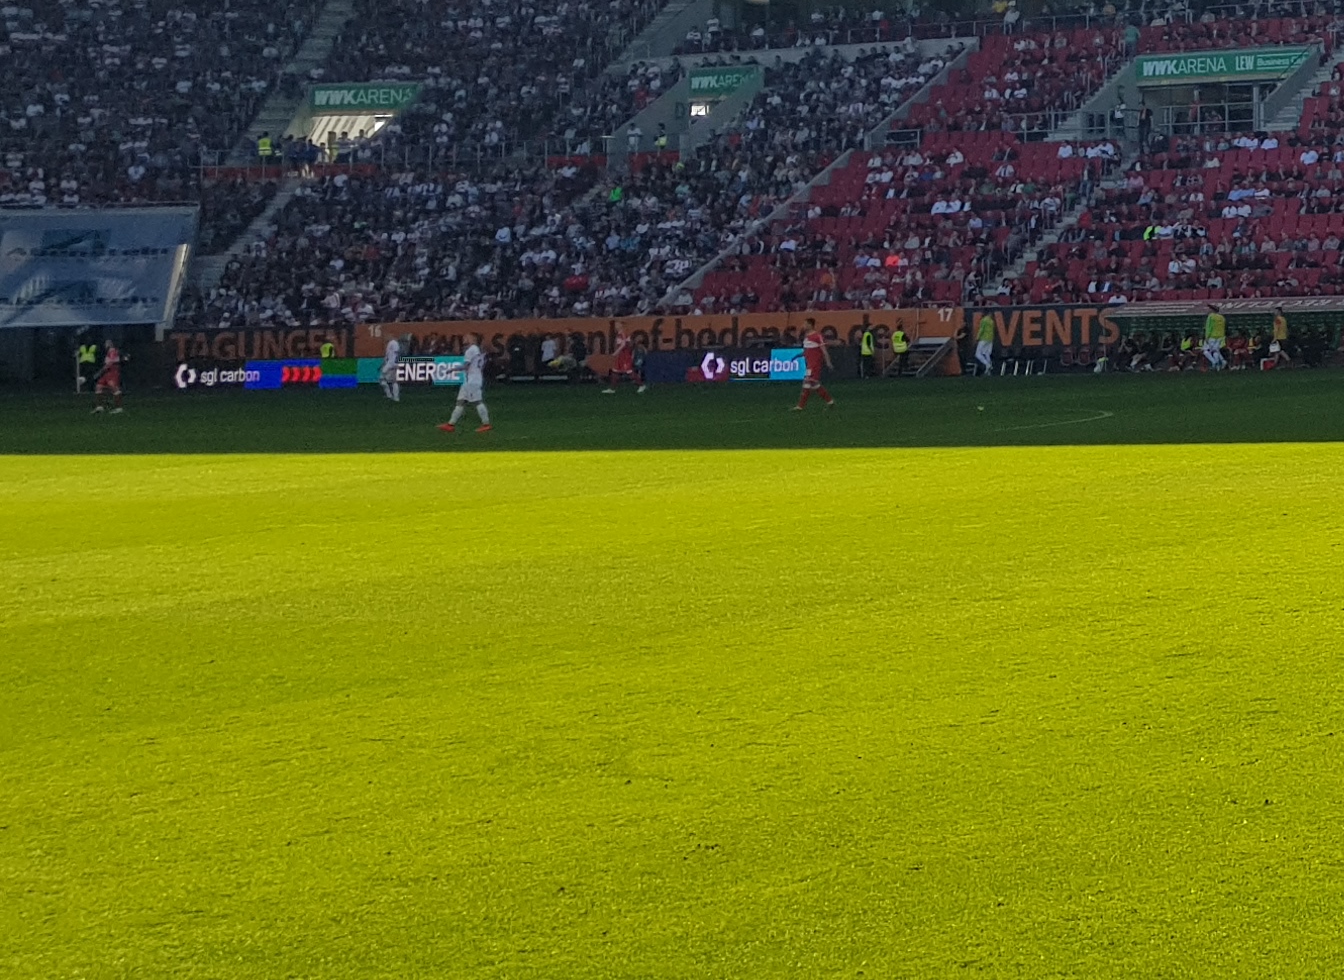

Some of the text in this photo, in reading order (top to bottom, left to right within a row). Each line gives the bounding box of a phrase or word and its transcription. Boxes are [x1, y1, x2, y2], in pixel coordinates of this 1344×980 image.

[1235, 54, 1255, 71] LEW
[938, 308, 954, 322] 17
[368, 324, 381, 338] 16
[729, 356, 799, 376] sgl carbon
[199, 368, 260, 386] sgl carbon
